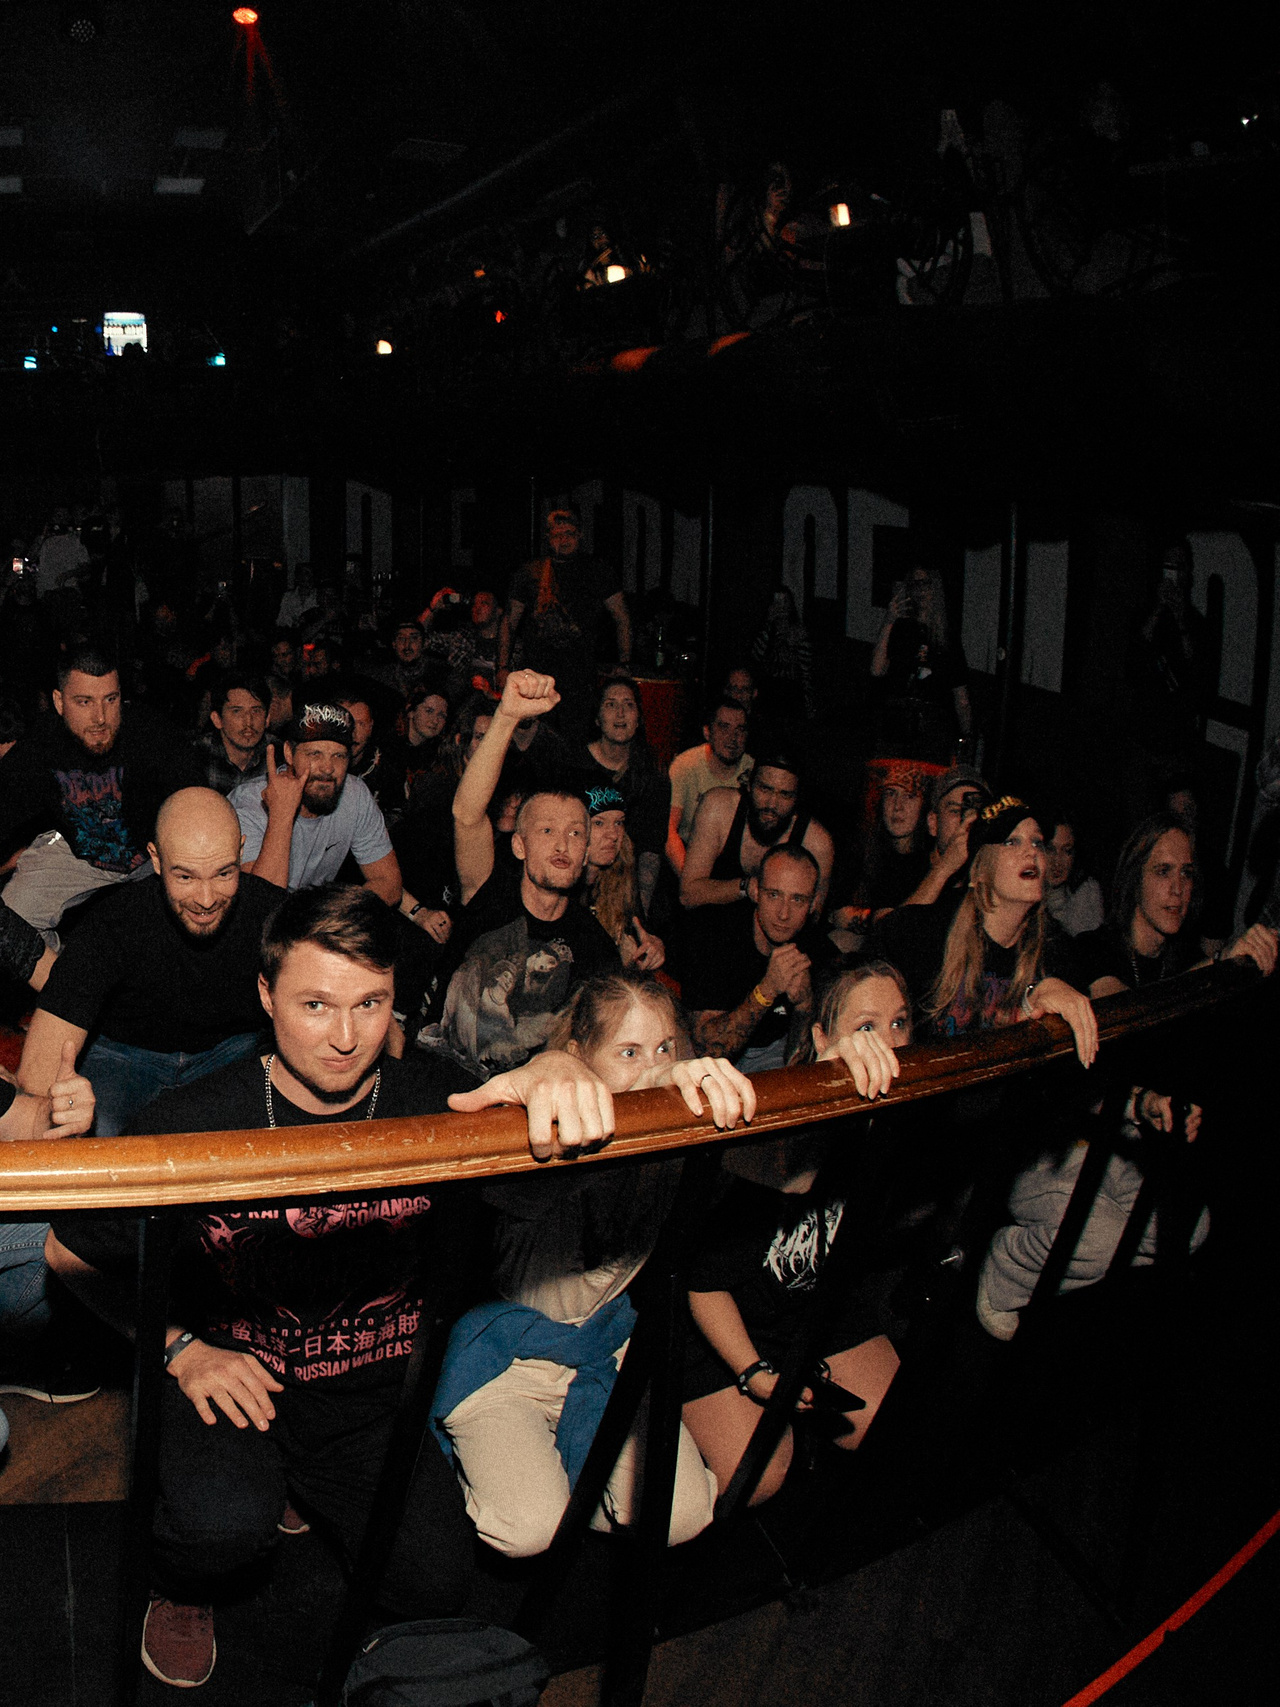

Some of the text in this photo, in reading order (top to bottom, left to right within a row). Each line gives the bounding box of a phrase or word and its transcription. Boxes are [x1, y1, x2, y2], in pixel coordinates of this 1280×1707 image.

[345, 1195, 432, 1230] COMANDOS
[293, 1358, 351, 1382] RUSSIAN
[351, 1346, 385, 1369] WILD
[386, 1339, 413, 1359] EAS
